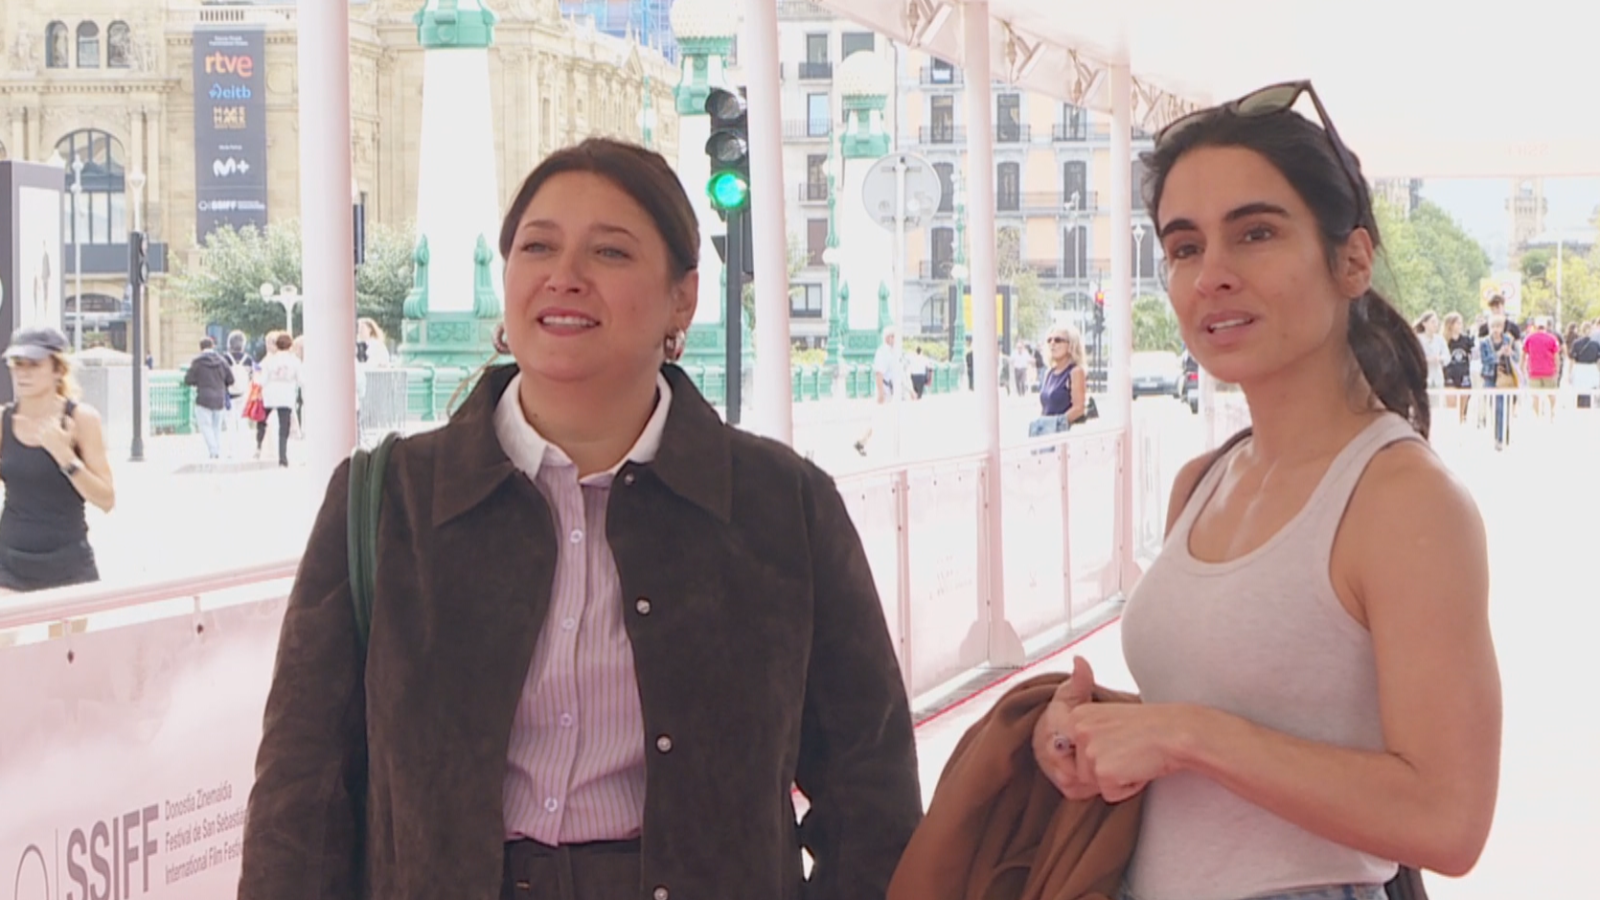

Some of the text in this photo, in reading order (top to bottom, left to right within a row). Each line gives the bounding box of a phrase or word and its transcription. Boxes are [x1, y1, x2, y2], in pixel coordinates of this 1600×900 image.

[205, 50, 253, 77] rtve
[222, 84, 251, 99] eitb
[165, 780, 232, 820] Donostia Zinemaldia
[67, 804, 158, 900] SSIFF
[165, 823, 191, 853] Festival
[193, 821, 201, 842] de
[203, 818, 215, 839] San
[165, 849, 207, 885] International
[209, 846, 222, 868] Film
